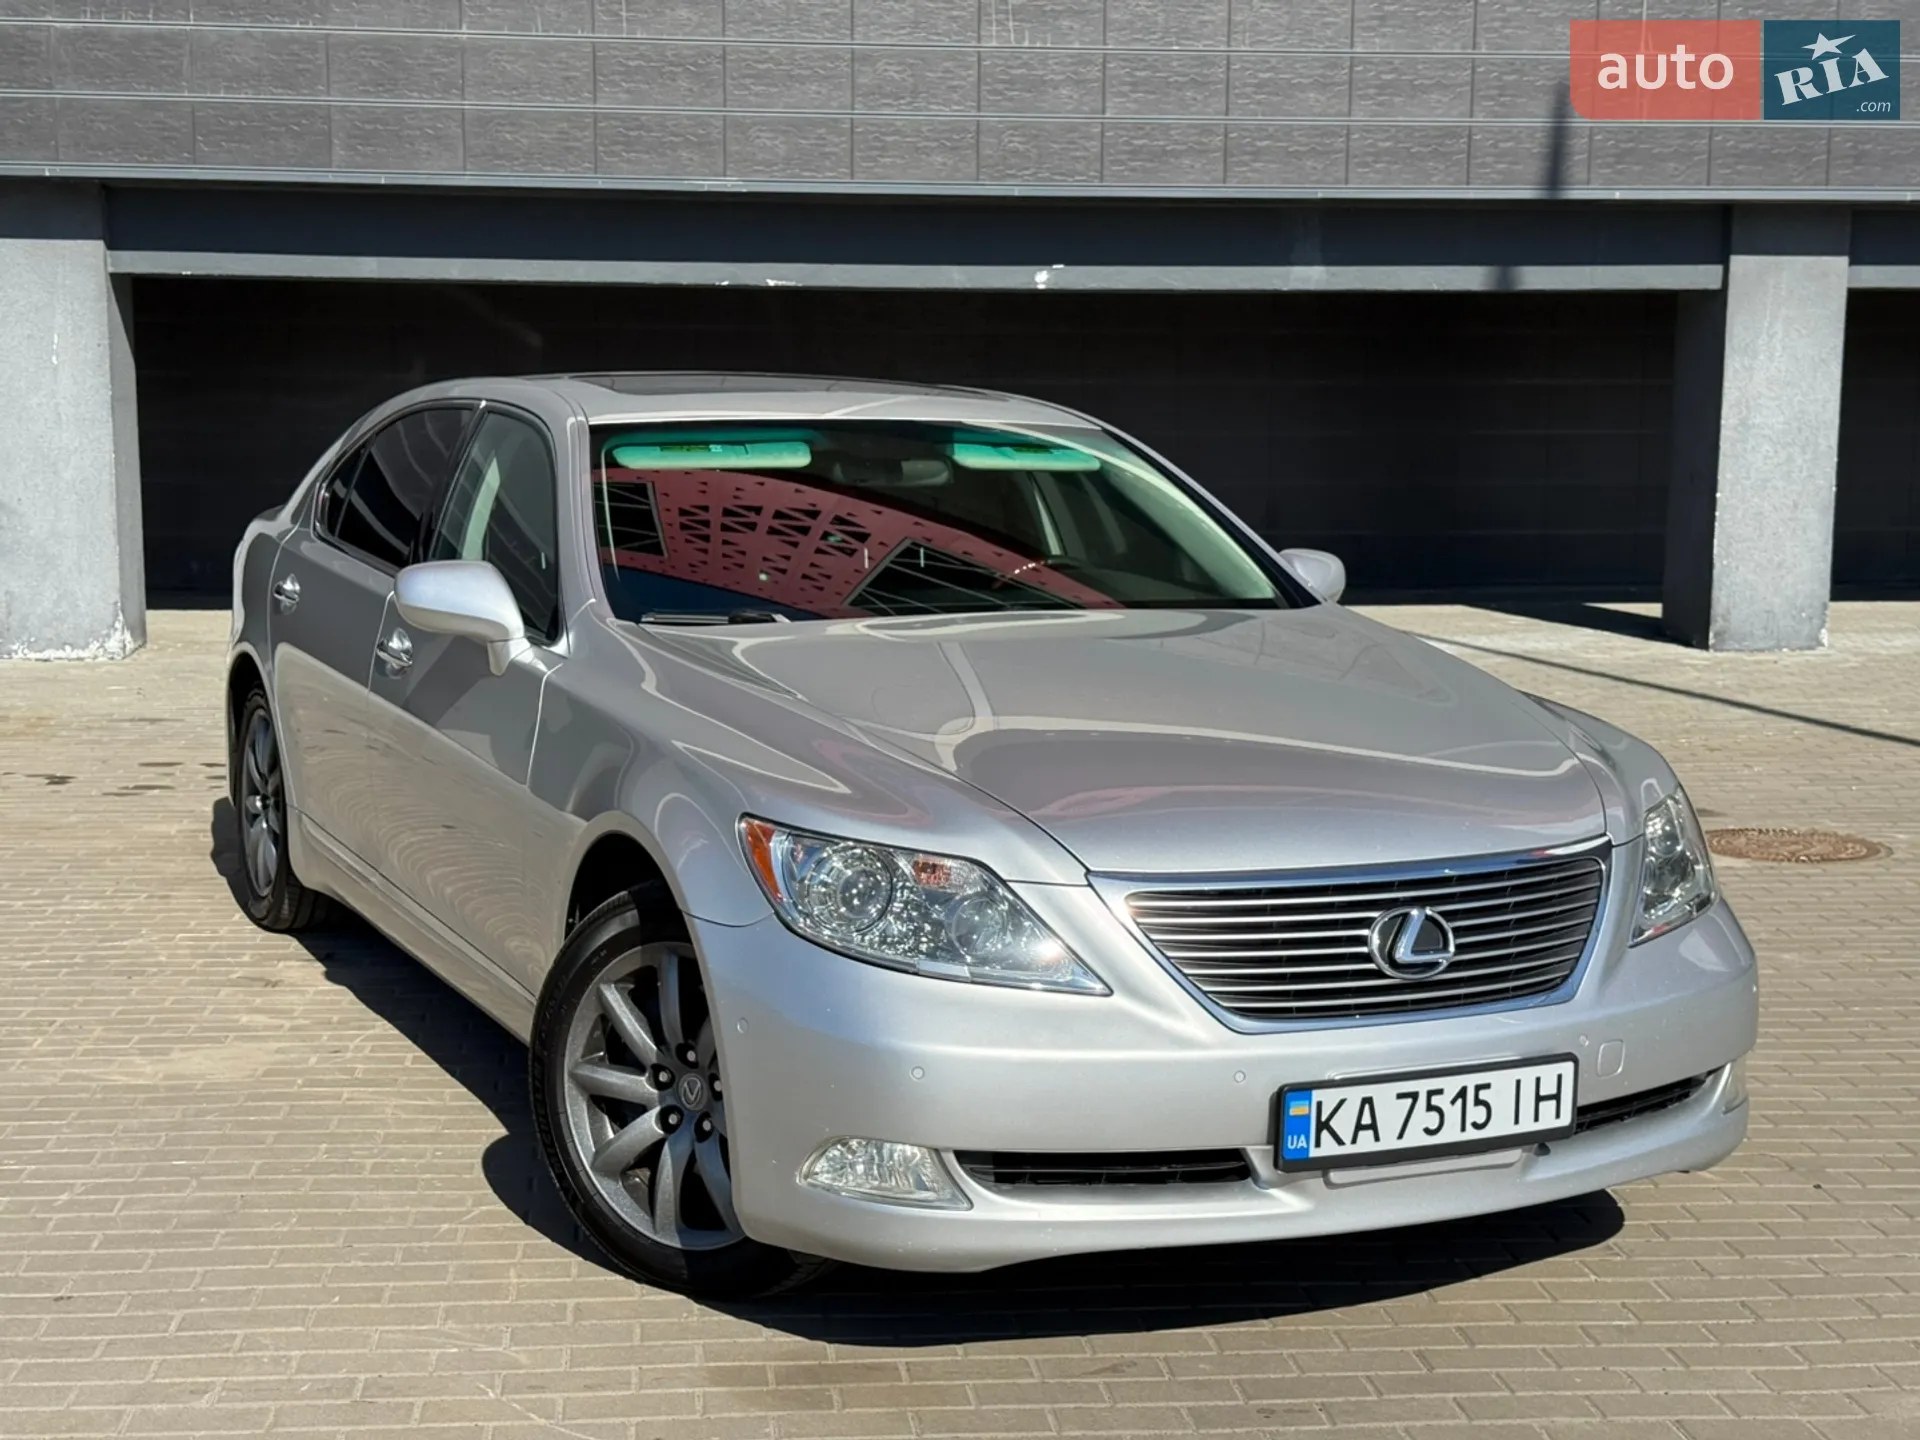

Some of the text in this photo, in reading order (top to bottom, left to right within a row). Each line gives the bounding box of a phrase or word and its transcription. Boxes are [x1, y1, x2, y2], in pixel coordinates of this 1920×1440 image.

[1314, 1073, 1563, 1149] KA 7515 IH
[1287, 1135, 1308, 1150] UA
